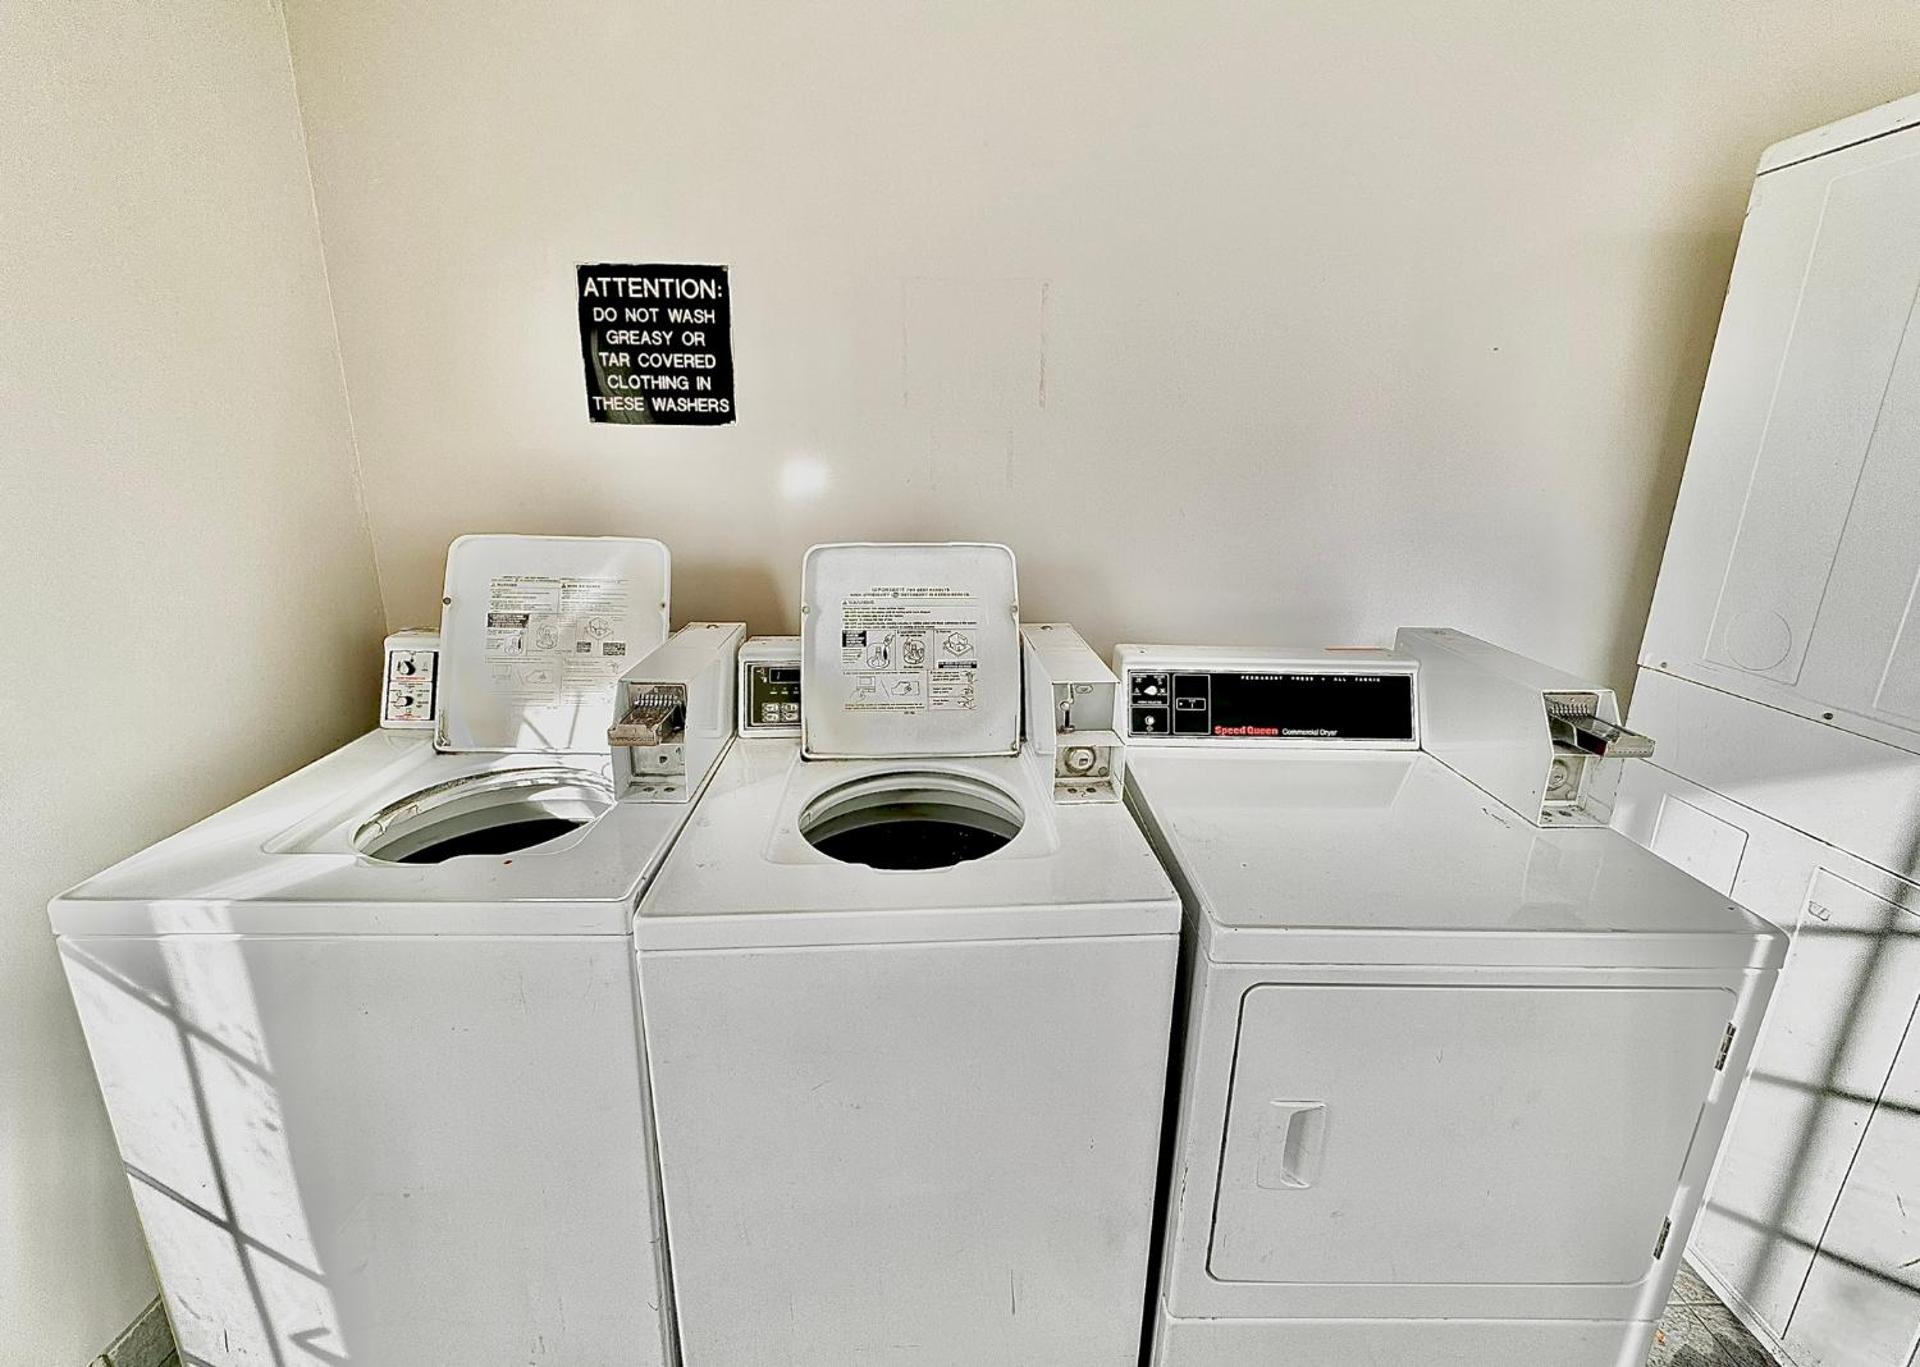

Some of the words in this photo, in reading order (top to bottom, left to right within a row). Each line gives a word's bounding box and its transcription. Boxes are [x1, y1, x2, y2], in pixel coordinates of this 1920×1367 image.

[584, 277, 722, 299] ATTENTION:
[594, 308, 617, 321] DO
[626, 308, 658, 322] NOT
[668, 309, 714, 323] WASH
[606, 330, 672, 345] GREASY
[682, 331, 705, 346] OR
[599, 352, 630, 367] TAR
[638, 353, 716, 368] COVERED
[608, 375, 689, 390] CLOTHING
[697, 376, 711, 390] IN
[593, 396, 644, 411] THESE
[652, 398, 729, 412] WASHERS
[1214, 726, 1246, 736] Speed
[1247, 726, 1279, 736] Queen
[1320, 728, 1338, 737] Dryer
